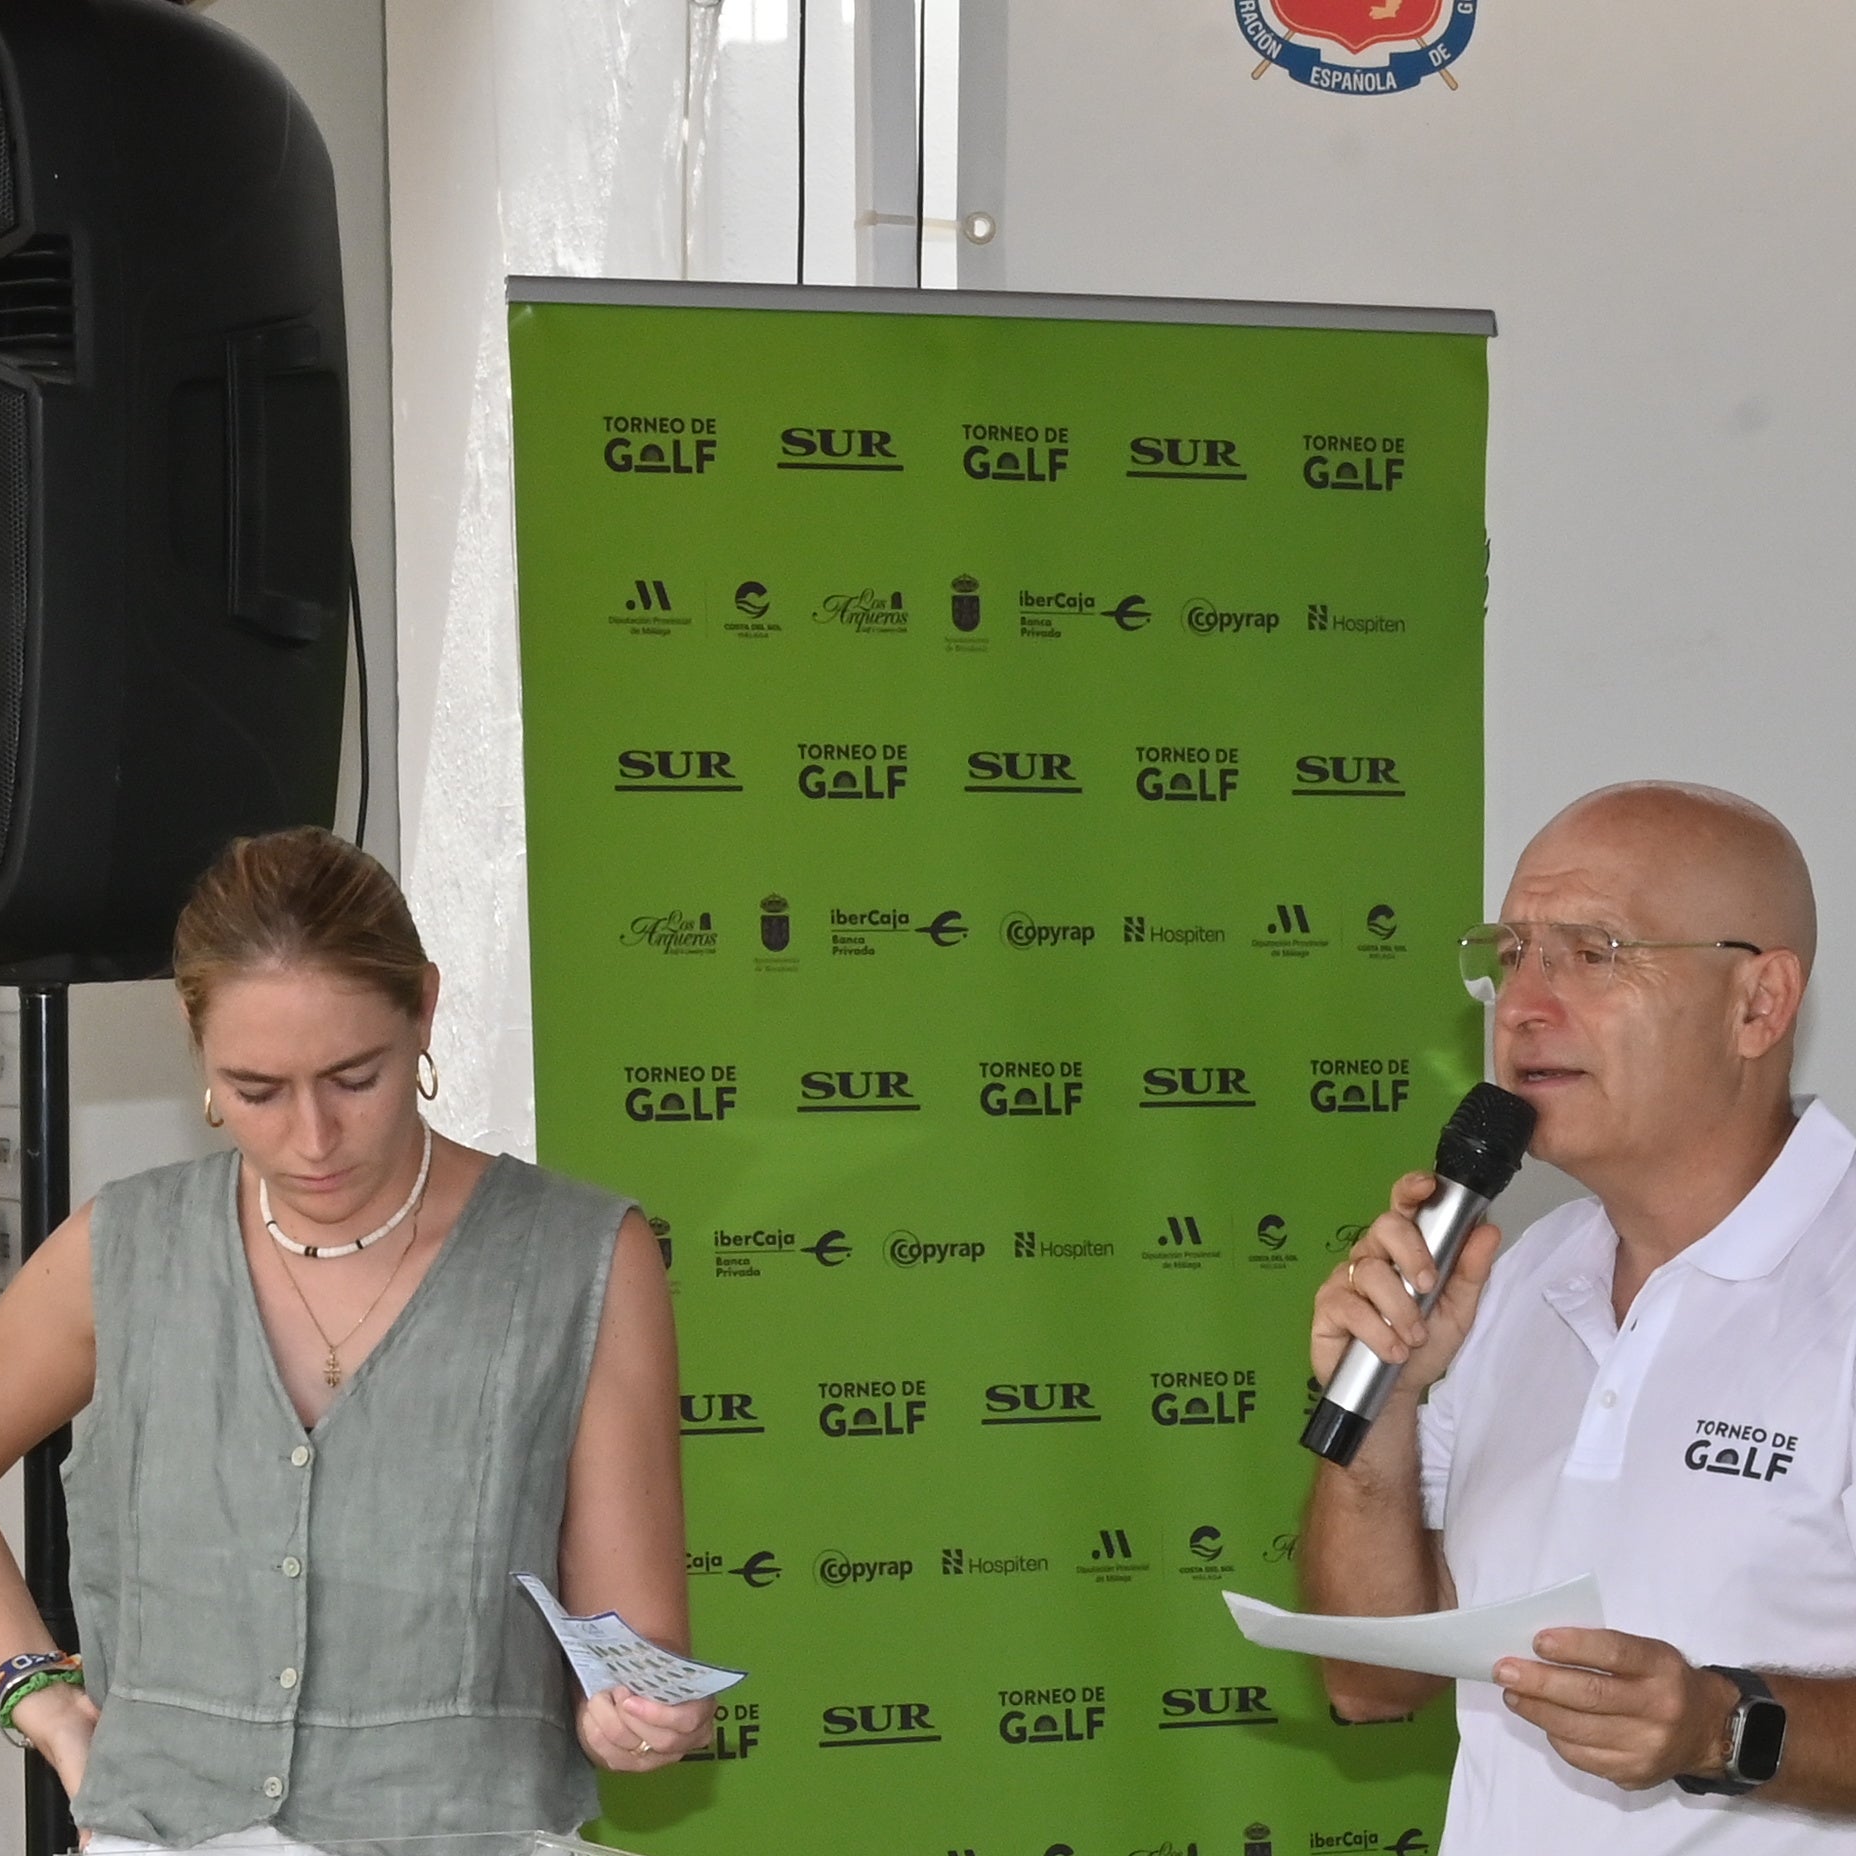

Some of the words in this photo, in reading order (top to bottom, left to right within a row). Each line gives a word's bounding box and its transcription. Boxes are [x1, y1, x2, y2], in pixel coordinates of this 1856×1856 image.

[1428, 43, 1452, 67] DE
[1310, 66, 1398, 92] ESPAÑOLA
[602, 415, 686, 435] TORNEO
[690, 417, 717, 435] DE
[961, 423, 1039, 443] TORNEO
[1044, 426, 1069, 444] DE
[780, 427, 897, 458] SUR
[1129, 436, 1241, 468] SUR
[1302, 434, 1377, 453] TORNEO
[1381, 437, 1405, 454] DE
[1332, 614, 1406, 635] Hospiten
[618, 749, 736, 780] SUR
[797, 743, 877, 761] TORNEO
[882, 744, 908, 761] DE
[967, 750, 1077, 781] SUR
[1295, 755, 1401, 785] SUR
[1150, 924, 1226, 946] Hospiten
[623, 1065, 706, 1084] TORNEO
[711, 1065, 737, 1082] DE
[1309, 1059, 1384, 1076] TORNEO
[1387, 1058, 1410, 1075] DE
[800, 1071, 915, 1100] SUR
[1142, 1067, 1251, 1096] SUR
[1040, 1239, 1115, 1261] Hospiten
[1149, 1370, 1229, 1389] TORNEO
[1233, 1369, 1257, 1387] DE
[681, 1394, 759, 1423] UR
[985, 1382, 1096, 1413] SUR
[1695, 1418, 1766, 1444] TORNEO
[1771, 1432, 1798, 1451] DE
[968, 1555, 1049, 1577] Hospiten
[997, 1687, 1077, 1707] TORNEO
[1081, 1685, 1106, 1703] DE
[1161, 1685, 1273, 1717] SUR
[822, 1702, 936, 1735] SUR
